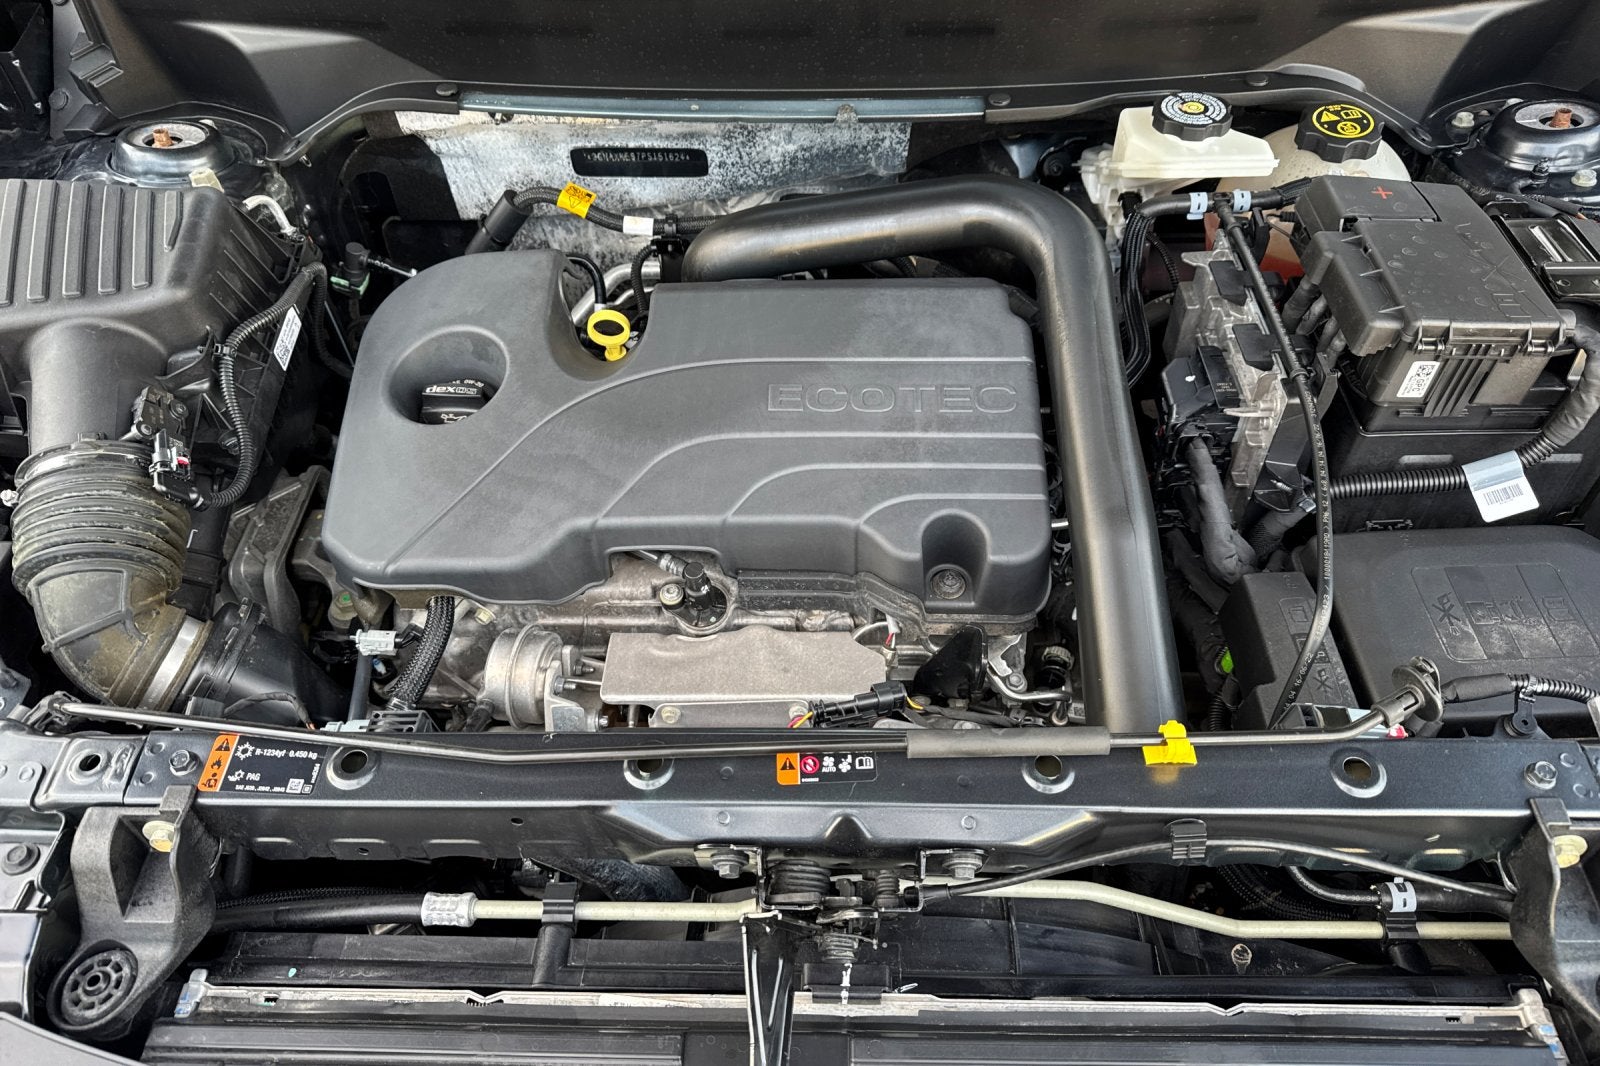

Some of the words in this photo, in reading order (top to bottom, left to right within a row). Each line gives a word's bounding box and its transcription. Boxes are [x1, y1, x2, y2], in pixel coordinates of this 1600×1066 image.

[767, 383, 1017, 413] ECOTEC
[255, 749, 286, 758] R-1234yf
[289, 751, 308, 759] 0.450
[308, 751, 318, 760] kg
[245, 772, 261, 782] PAG
